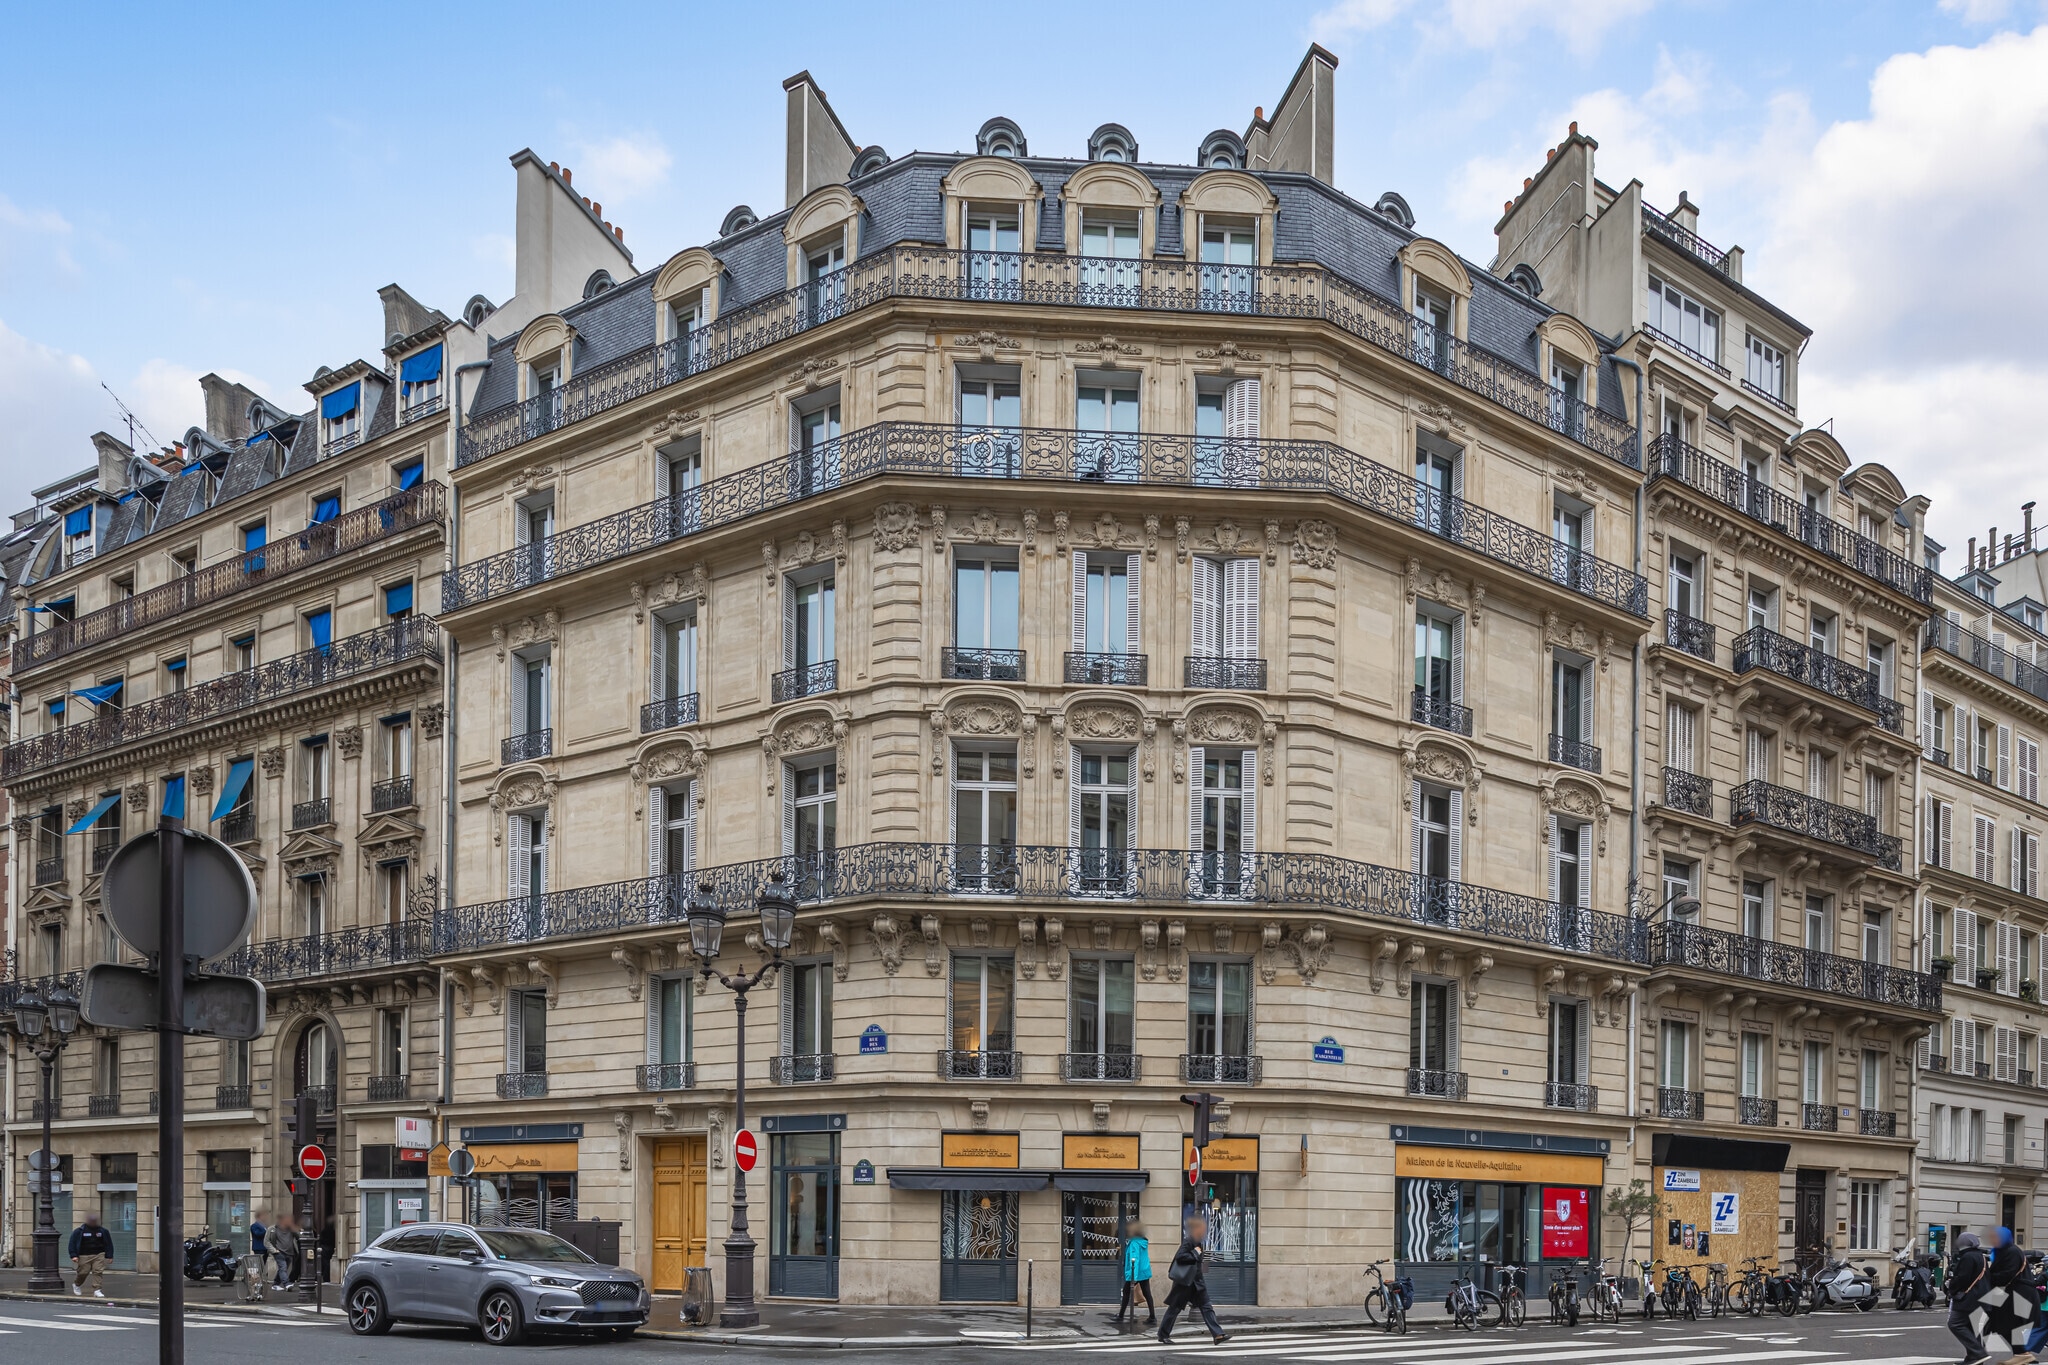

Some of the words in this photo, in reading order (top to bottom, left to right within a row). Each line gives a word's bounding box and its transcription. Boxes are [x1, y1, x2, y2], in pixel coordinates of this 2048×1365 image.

[1406, 1157, 1434, 1167] Maison
[1436, 1158, 1445, 1167] de
[1447, 1158, 1454, 1167] la
[1455, 1159, 1522, 1171] Nouvelle-Aquitaine
